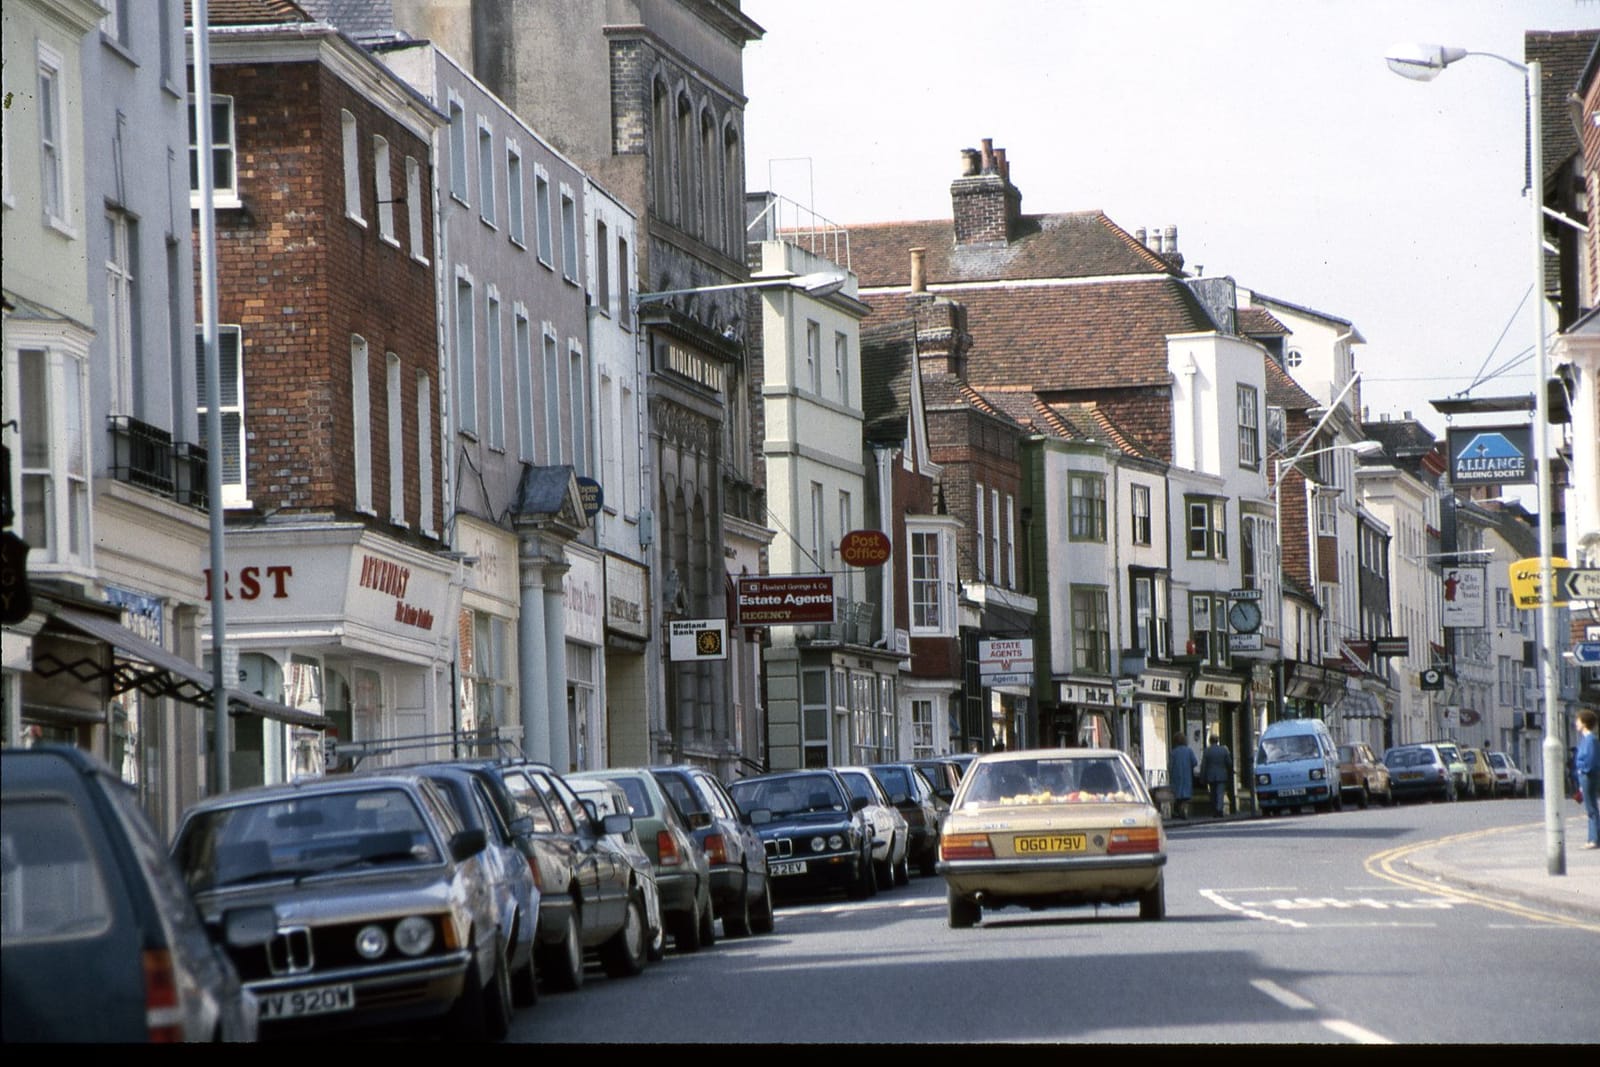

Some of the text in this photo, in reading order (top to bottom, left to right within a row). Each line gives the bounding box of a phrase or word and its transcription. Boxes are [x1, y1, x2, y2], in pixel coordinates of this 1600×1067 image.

[1457, 457, 1525, 471] ALLIANCE
[1457, 470, 1525, 479] BUILDING SOCIETY
[851, 534, 880, 547] Post
[846, 547, 886, 559] Office
[740, 593, 833, 606] Estate Agents
[741, 611, 792, 620] REGENCY
[992, 675, 1018, 683] Agents
[1020, 836, 1081, 851] OGO 179V
[291, 987, 349, 1013] 920W
